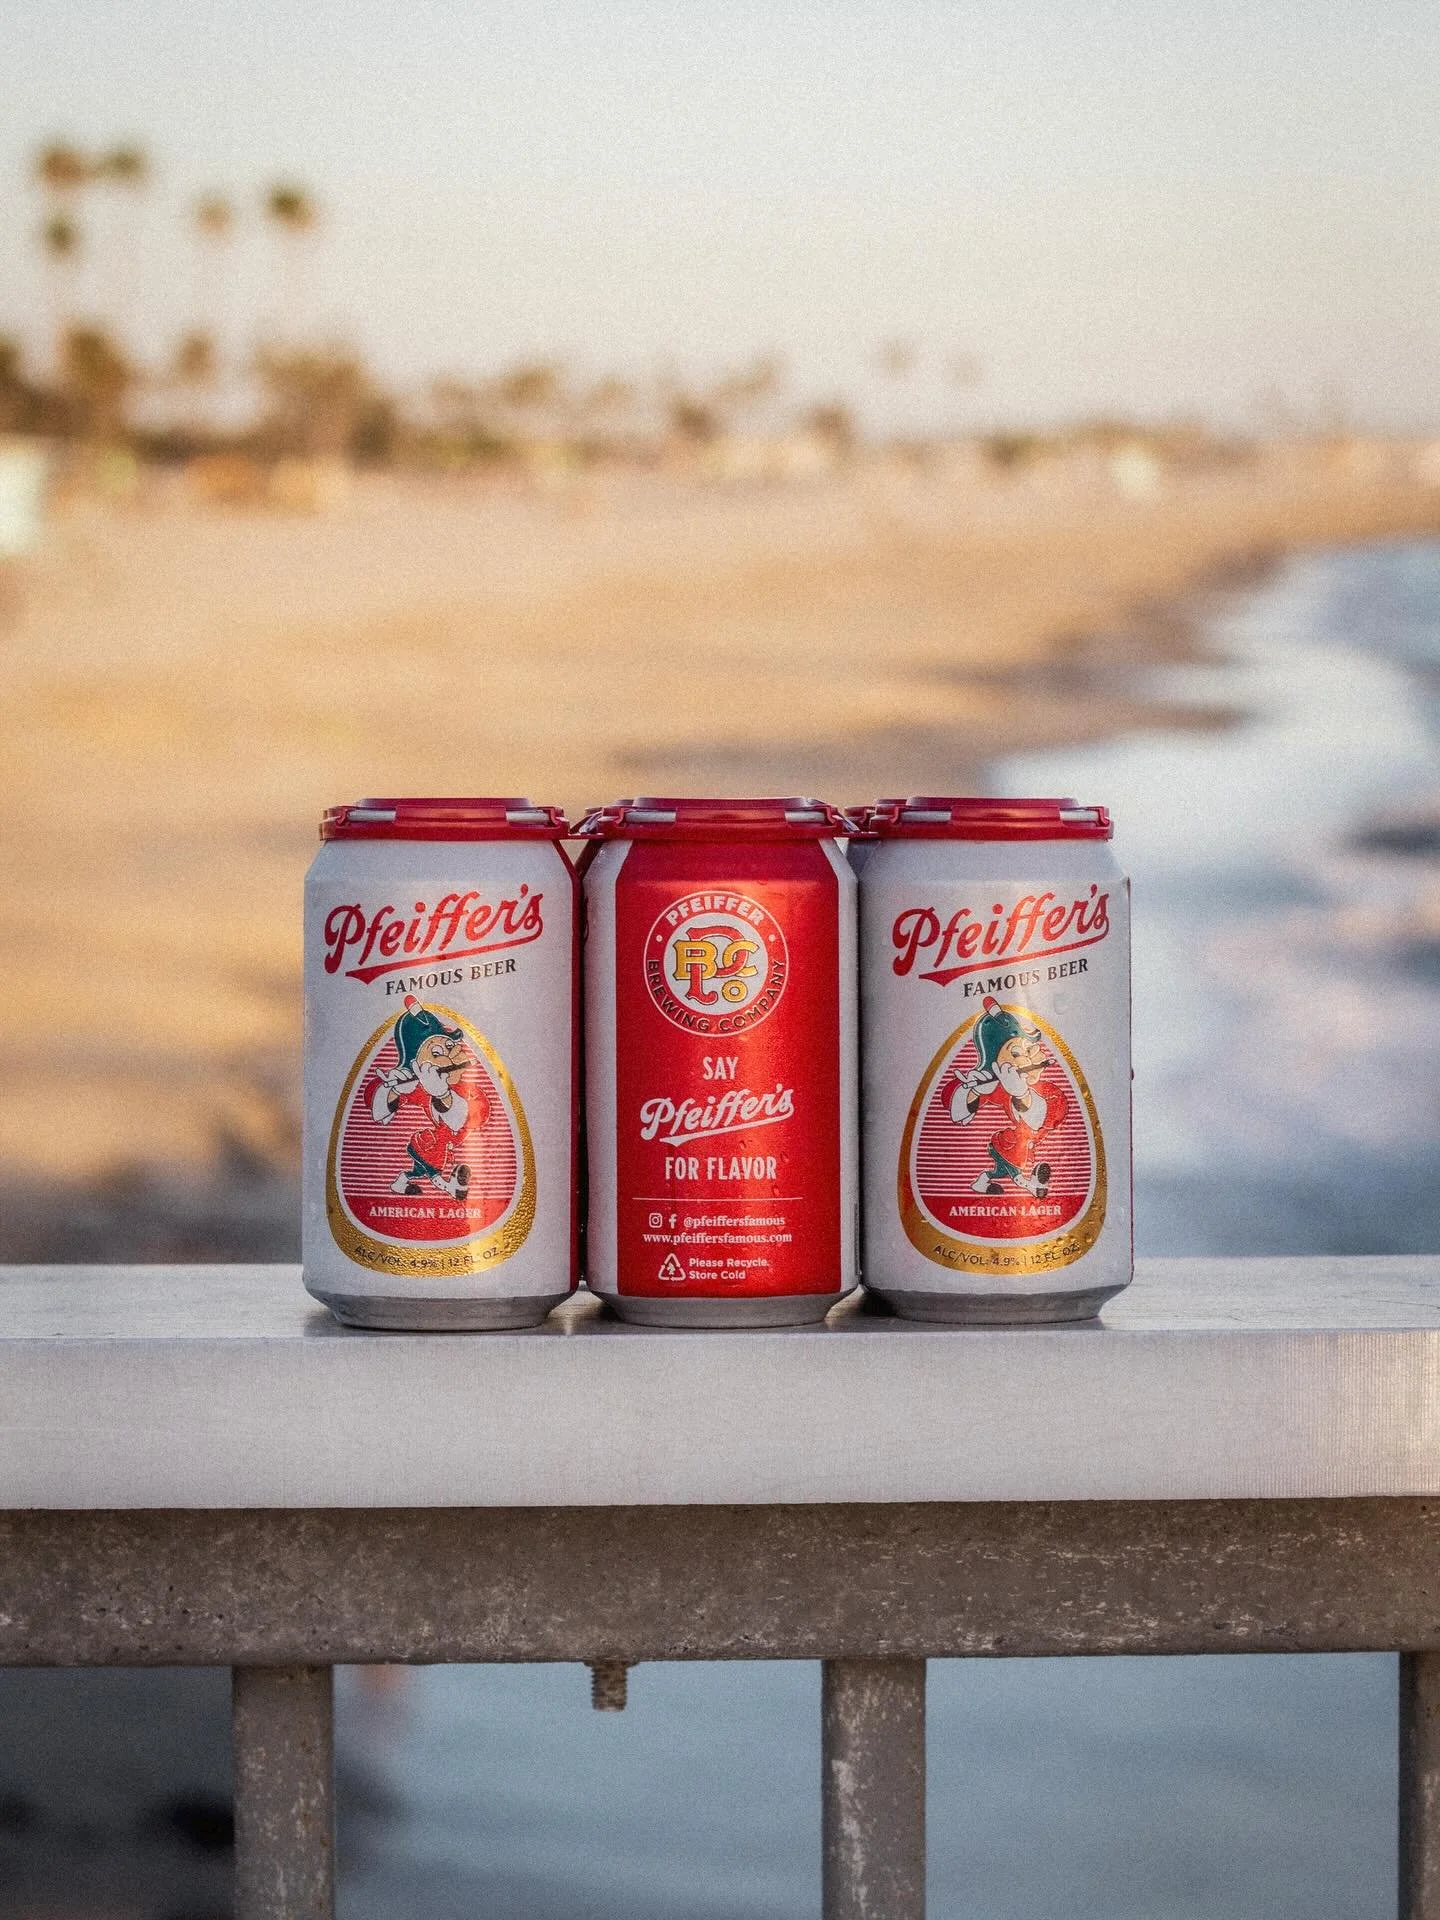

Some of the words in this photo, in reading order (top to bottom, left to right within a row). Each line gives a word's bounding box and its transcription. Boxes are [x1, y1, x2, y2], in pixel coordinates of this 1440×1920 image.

[665, 895, 765, 926] PFEIFFER
[324, 883, 543, 985] Pfeiffer's
[892, 883, 1110, 987] Pfeiffer's
[384, 968, 463, 995] FAMOUS
[471, 958, 516, 980] BEER
[963, 970, 1040, 998] FAMOUS
[1047, 958, 1089, 981] BEER
[648, 959, 710, 1032] BREWING
[719, 958, 786, 1031] COMPANY
[702, 1056, 739, 1080] SAY
[640, 1083, 795, 1147] Pfeiffer's
[665, 1156, 699, 1180] FOR
[706, 1156, 777, 1180] FLAVOR
[369, 1206, 435, 1219] AMERICAN
[438, 1206, 482, 1219] LAGER
[683, 1214, 786, 1228] @pfeiffersfamous
[949, 1205, 1017, 1217] AMERICAN
[1021, 1205, 1062, 1217] LAGER
[642, 1232, 793, 1246] www.pfeiffersfamous.com
[449, 1257, 460, 1267] 12
[688, 1257, 724, 1268] Please
[726, 1257, 770, 1269] Recycle.
[992, 1256, 1020, 1267] 4.9%
[1030, 1255, 1041, 1265] 12
[688, 1270, 718, 1280] Store
[720, 1270, 746, 1280] Cold
